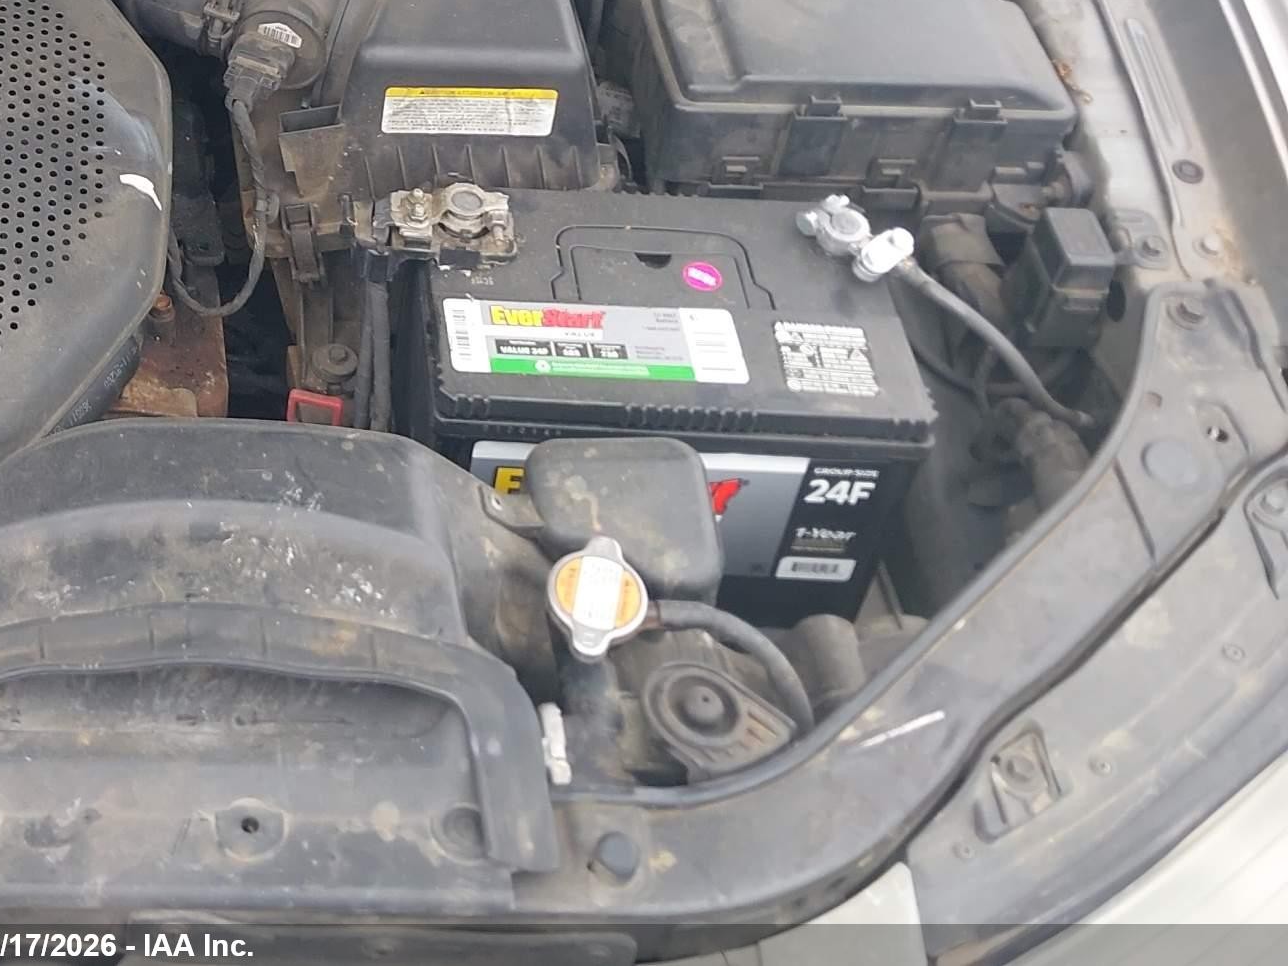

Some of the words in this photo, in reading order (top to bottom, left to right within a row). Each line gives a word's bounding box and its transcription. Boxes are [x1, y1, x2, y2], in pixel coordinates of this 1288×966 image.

[490, 305, 604, 330] EverStart
[814, 467, 853, 476] GROUP
[803, 478, 876, 505] 24F
[795, 527, 856, 539] 1-Year
